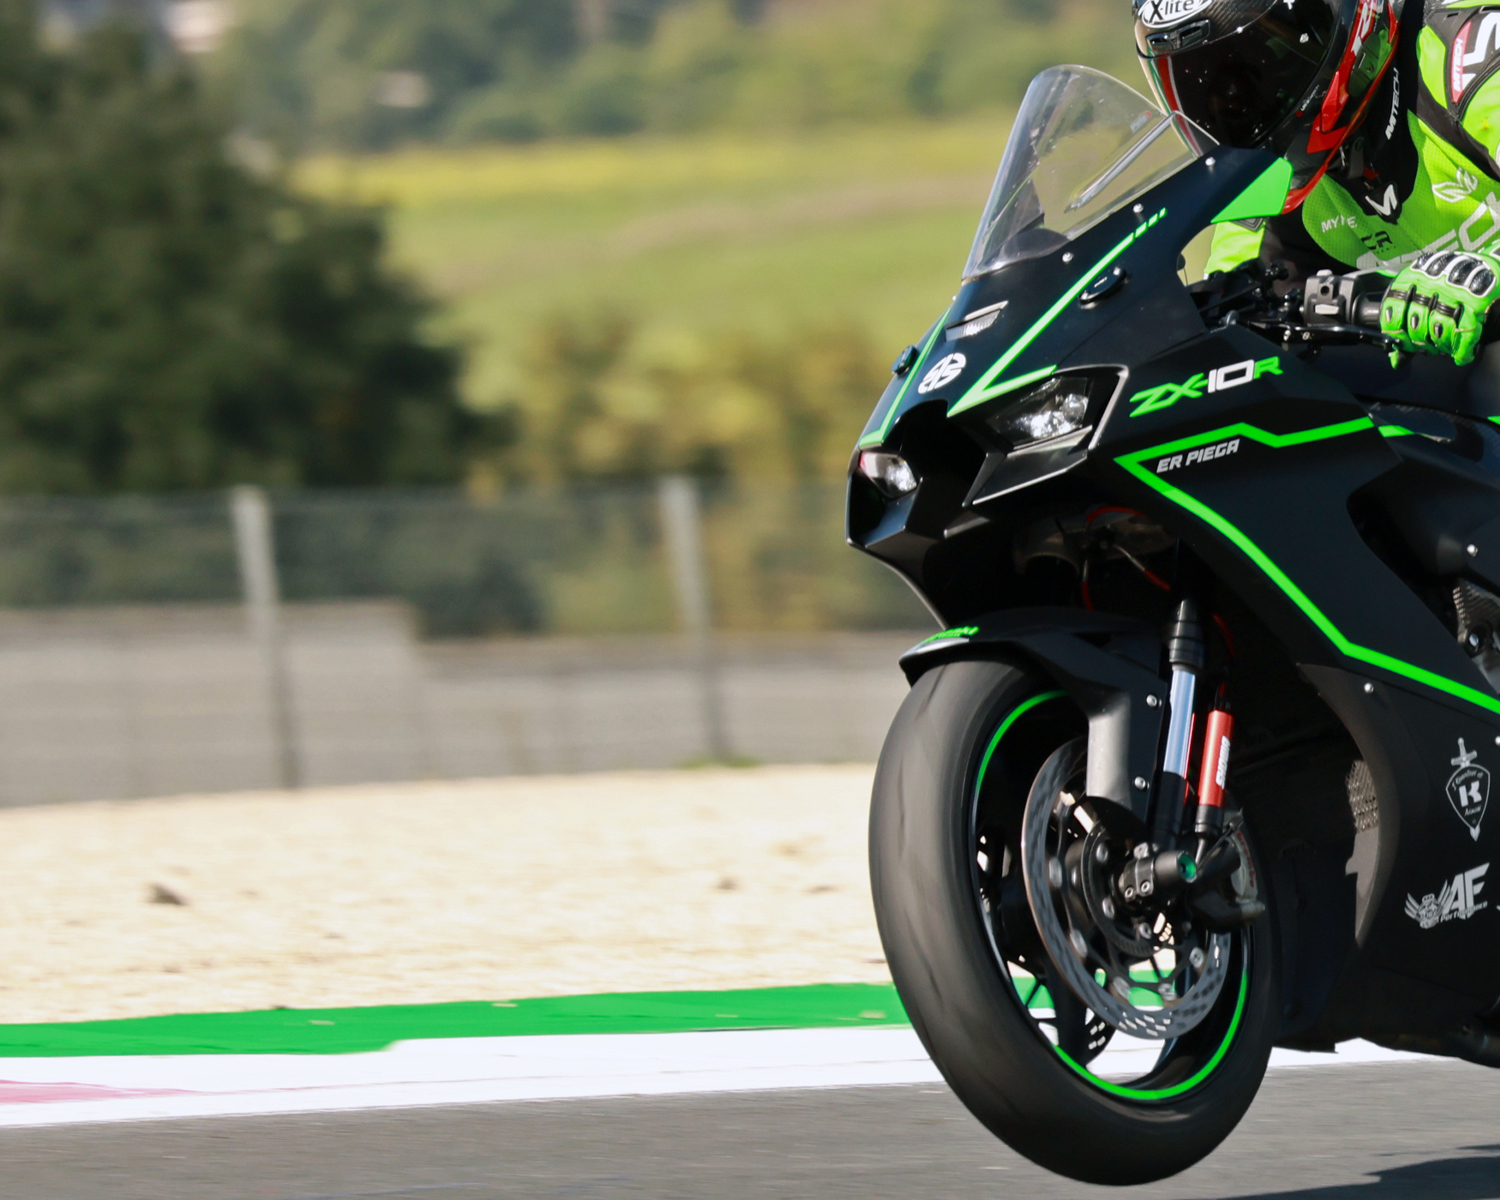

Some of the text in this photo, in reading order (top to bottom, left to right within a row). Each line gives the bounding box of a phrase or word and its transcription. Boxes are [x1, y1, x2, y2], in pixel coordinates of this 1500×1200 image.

[1149, 0, 1195, 24] X-lite
[1129, 356, 1283, 418] ZX-10R
[1156, 438, 1240, 474] ER PIEGA
[1215, 735, 1231, 790] SHOWA
